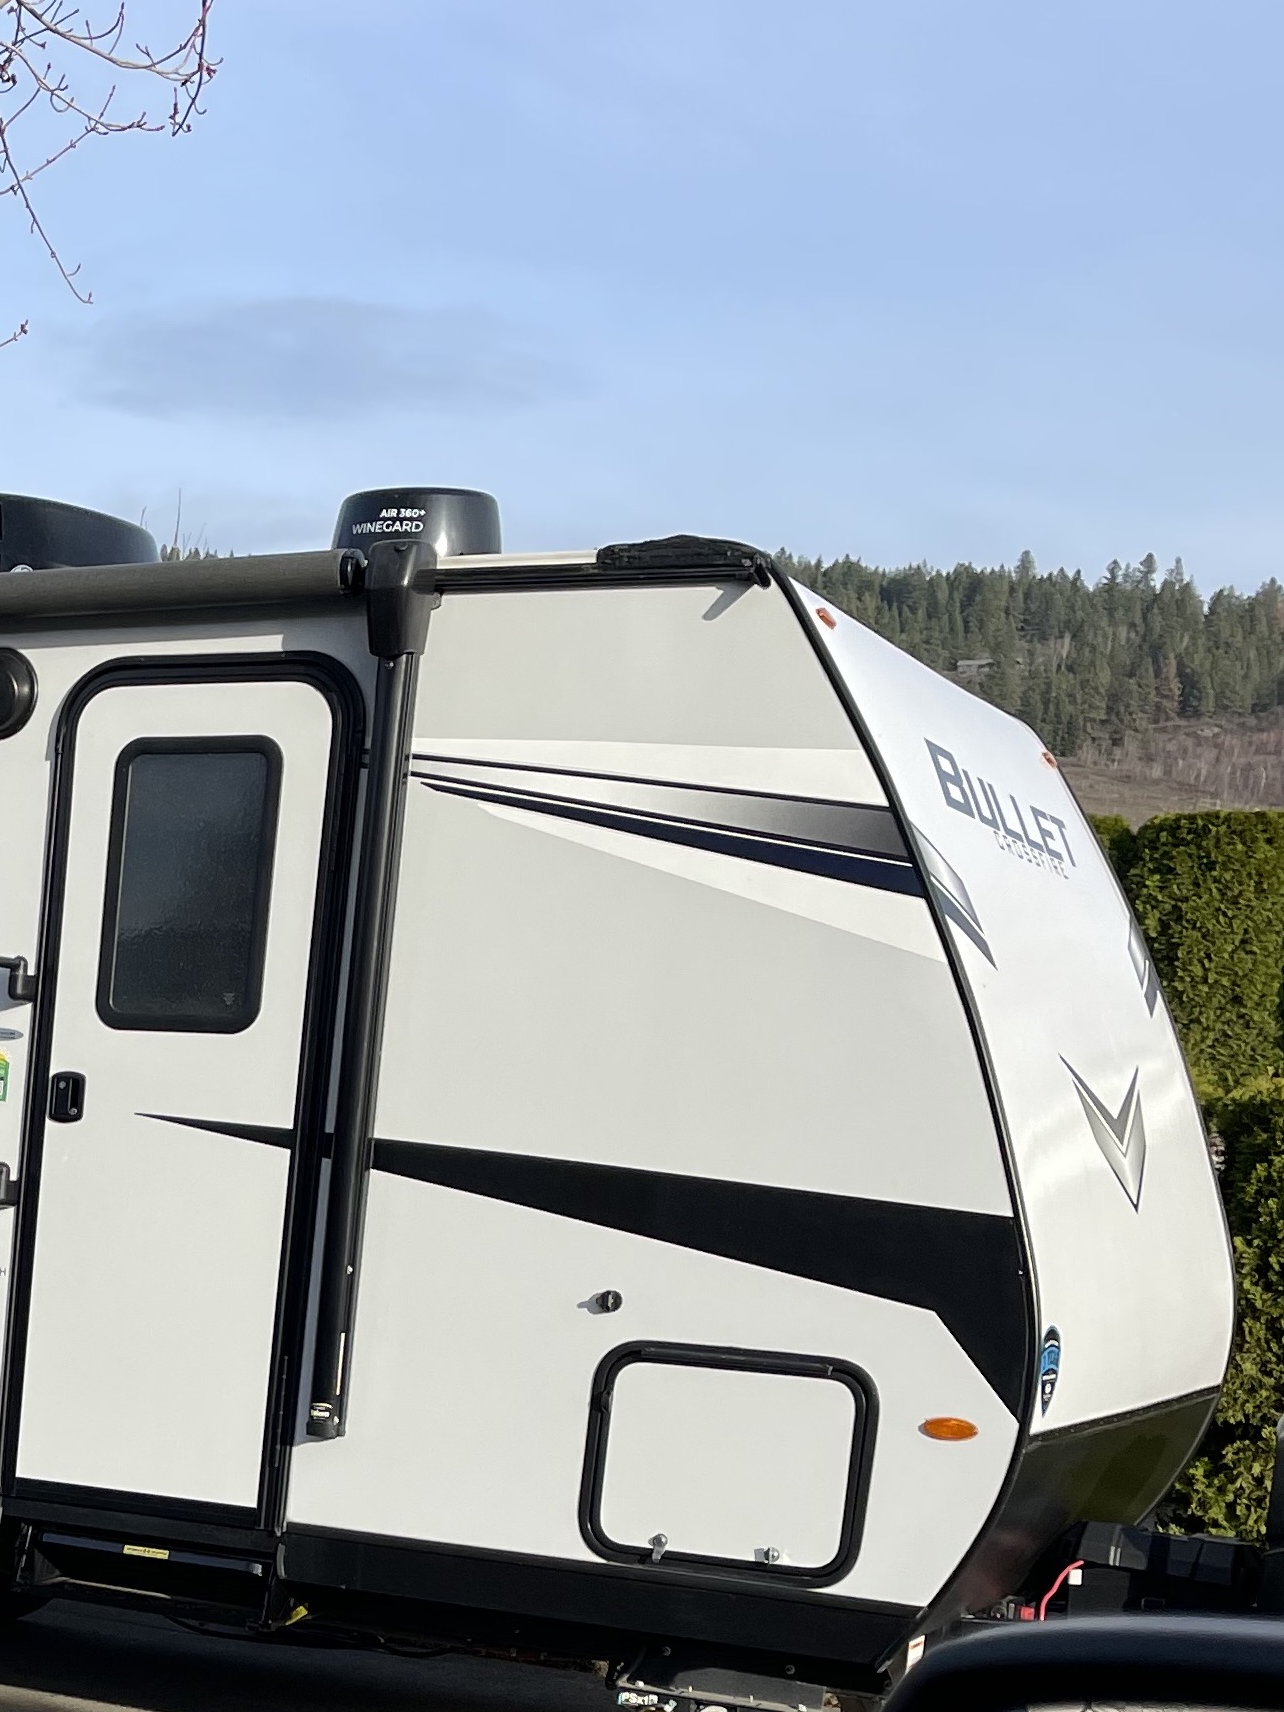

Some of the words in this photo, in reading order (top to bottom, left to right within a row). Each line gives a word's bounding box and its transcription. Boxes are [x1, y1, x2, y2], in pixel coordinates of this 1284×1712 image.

[379, 508, 398, 518] AIR
[352, 520, 424, 535] WINEGARD
[923, 736, 1077, 869] BULLET
